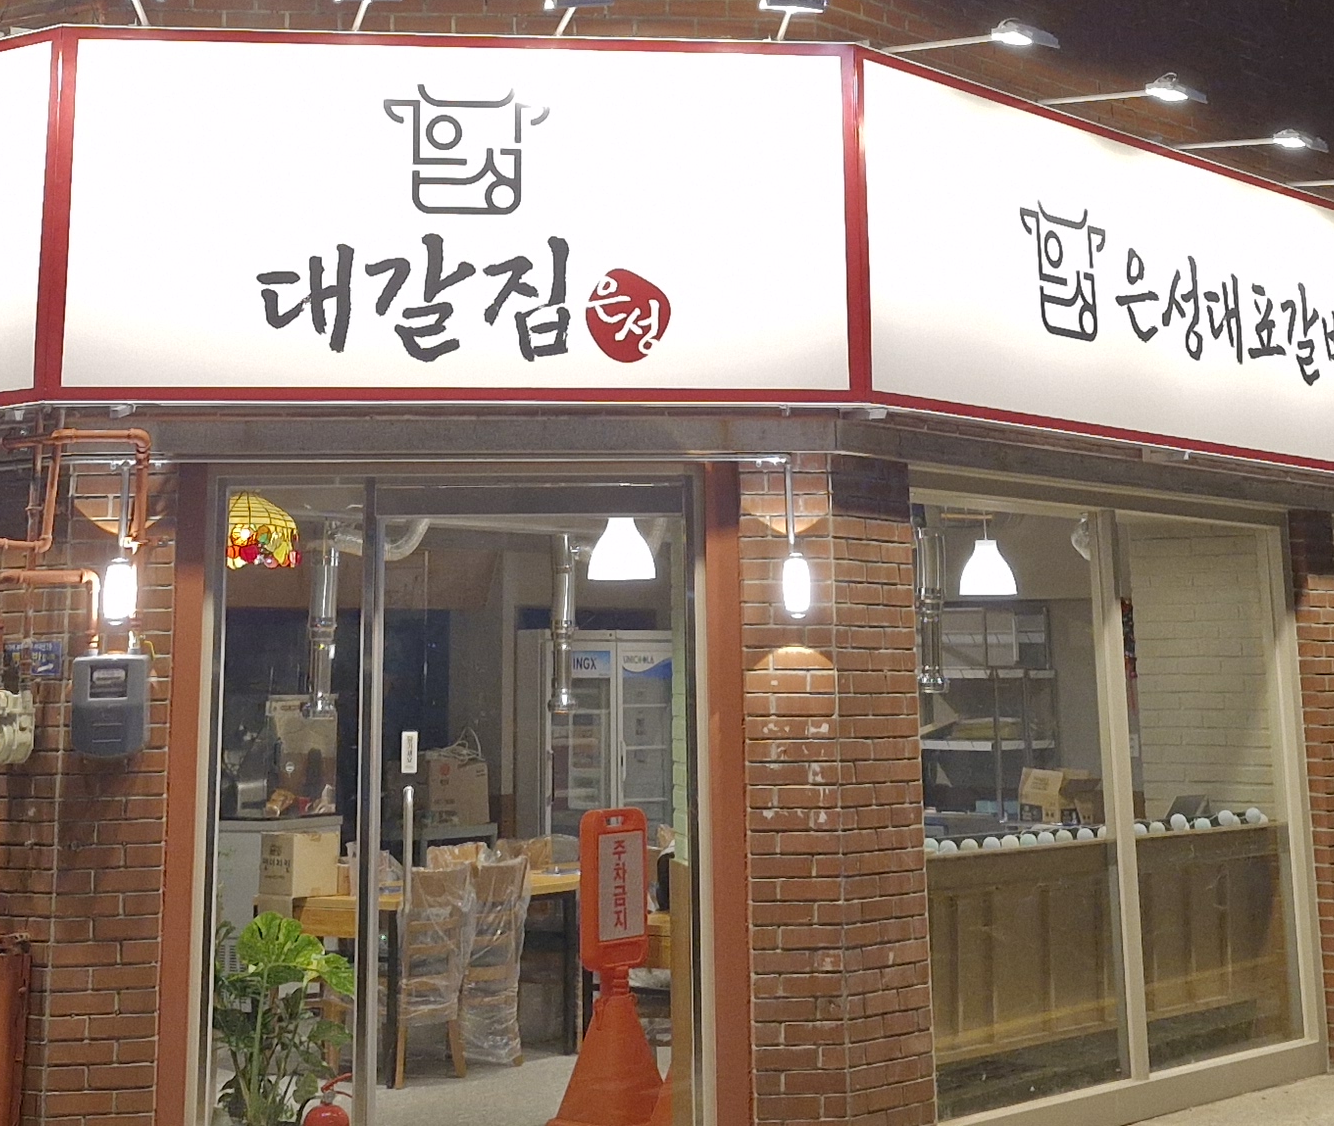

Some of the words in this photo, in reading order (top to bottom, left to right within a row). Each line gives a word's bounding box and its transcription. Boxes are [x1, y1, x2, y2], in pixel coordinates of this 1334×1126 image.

[256, 233, 570, 362] 대갈집
[572, 656, 598, 670] INGX
[612, 839, 628, 931] 주차금지
